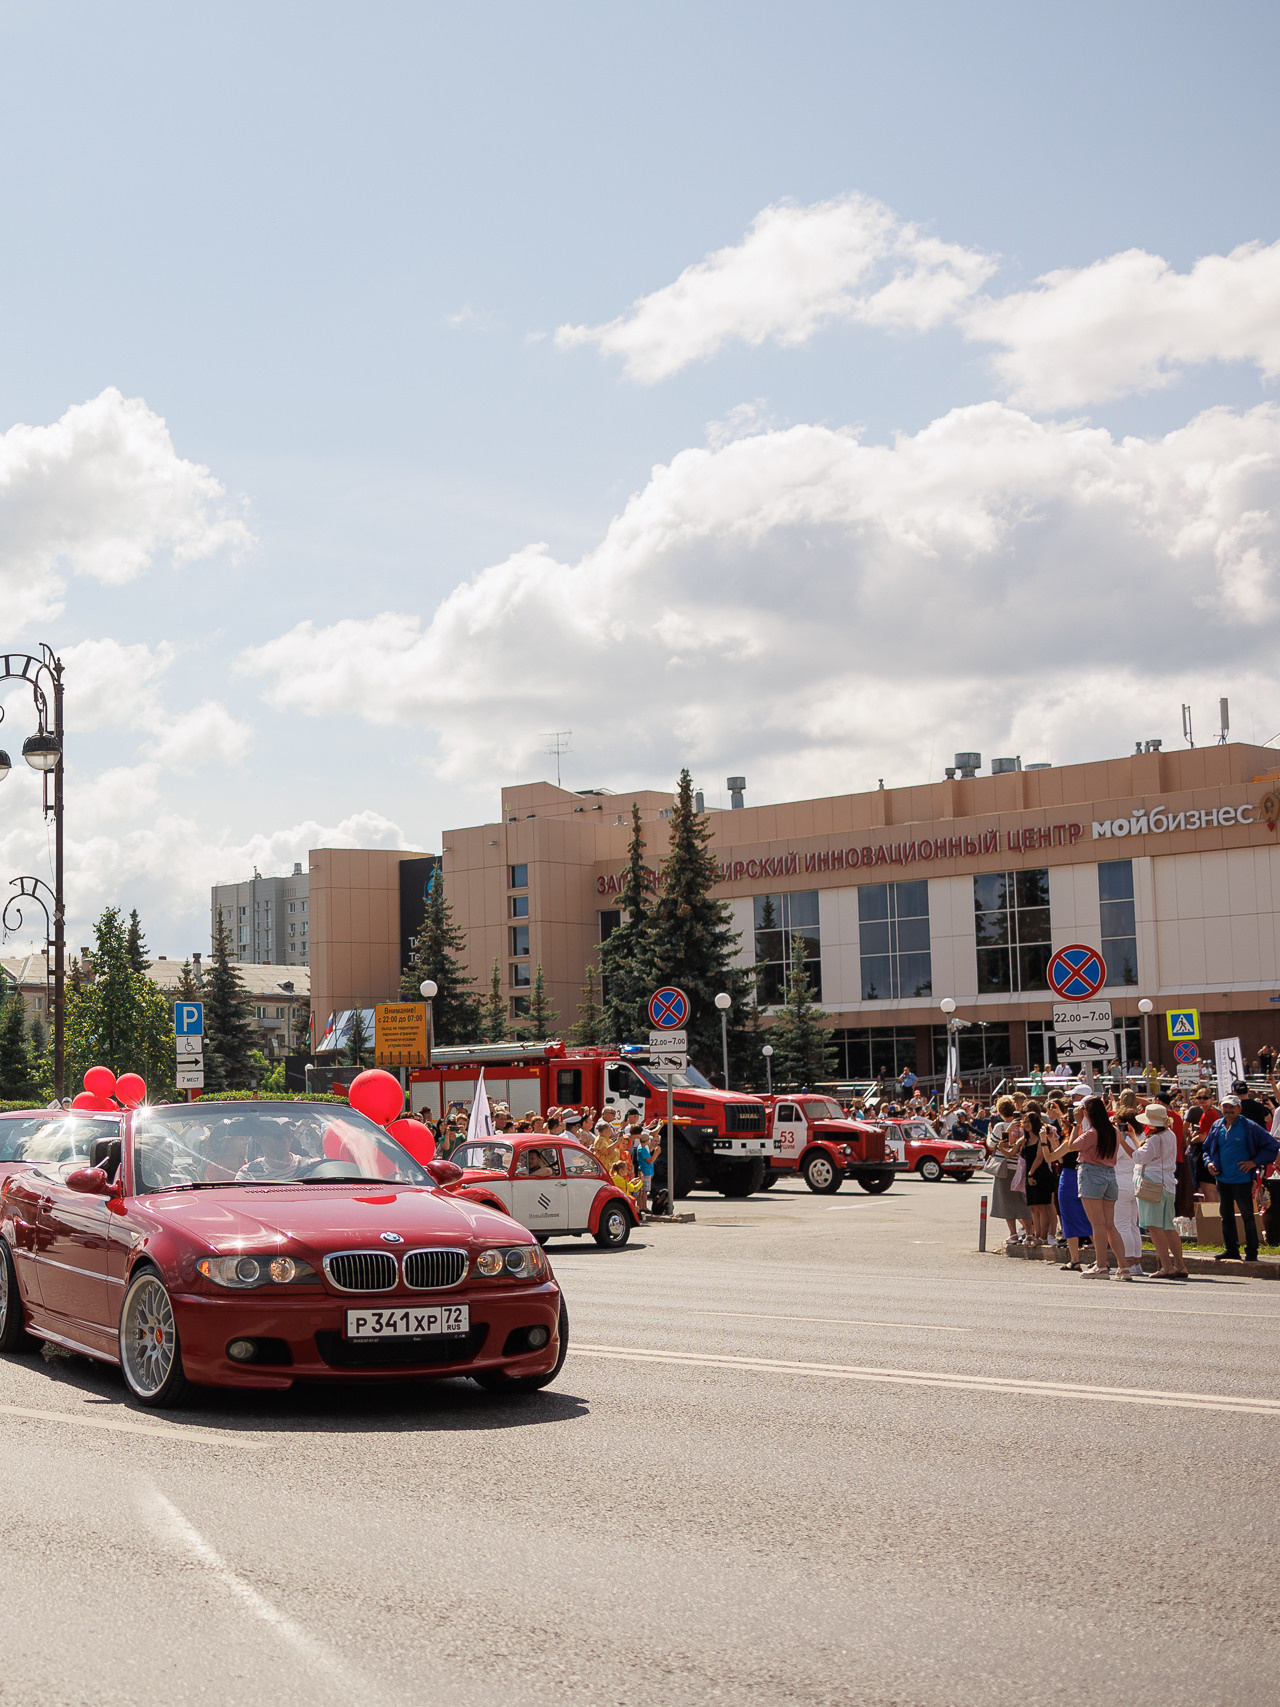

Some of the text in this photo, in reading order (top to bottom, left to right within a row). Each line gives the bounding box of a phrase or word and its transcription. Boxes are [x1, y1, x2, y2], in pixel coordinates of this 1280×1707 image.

[804, 827, 1001, 874] ИННОВАЦИОННЫЙ
[1007, 822, 1084, 854] ЦЕНТР
[384, 1006, 416, 1014] Внимание!
[382, 1015, 398, 1023] 22:00
[407, 1014, 423, 1022] 07:00
[780, 1130, 795, 1144] 53
[355, 1307, 463, 1334] Р341ХР 72
[446, 1323, 461, 1331] RUS
